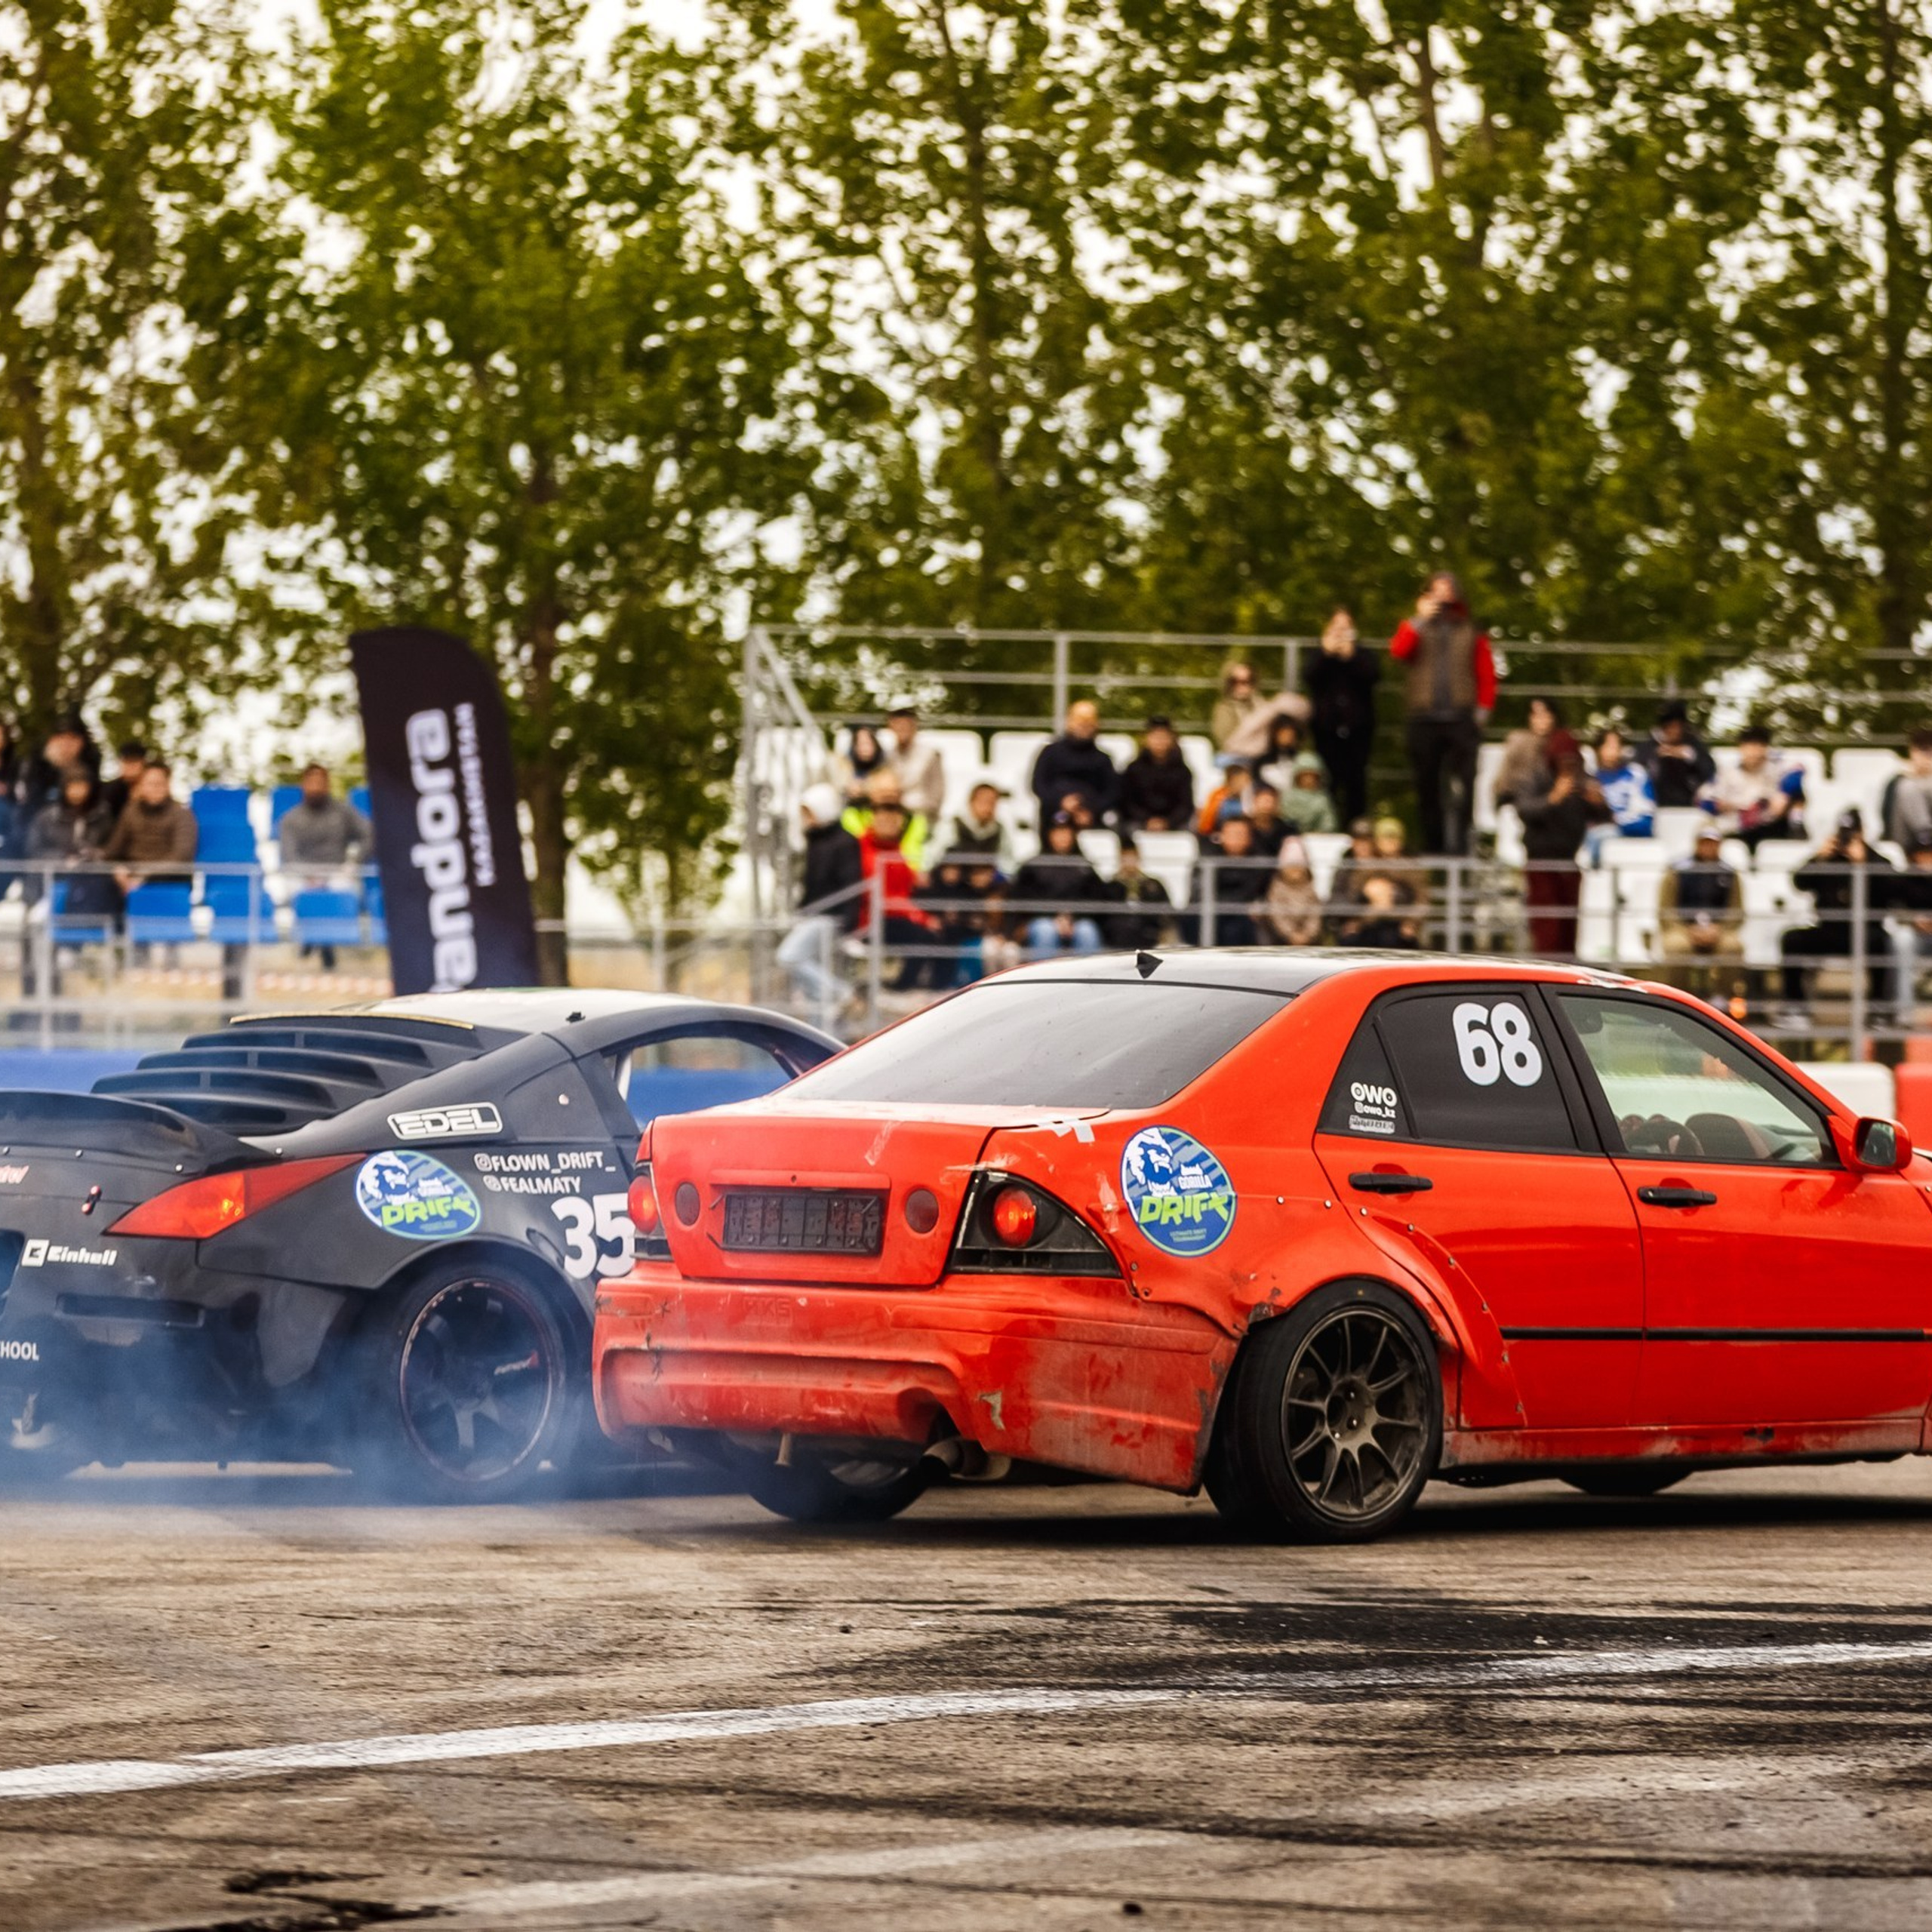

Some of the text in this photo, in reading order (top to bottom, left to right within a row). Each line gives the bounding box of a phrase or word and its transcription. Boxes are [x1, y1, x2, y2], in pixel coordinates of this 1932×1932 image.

[405, 707, 478, 993] andora
[1452, 1002, 1543, 1087] 68
[392, 1108, 500, 1137] EDEL
[1178, 1174, 1213, 1190] GORILLA
[381, 1196, 475, 1227] DRIFT
[1138, 1191, 1229, 1226] DRIFT
[550, 1192, 636, 1279] 35
[0, 1340, 40, 1361] HOOL
